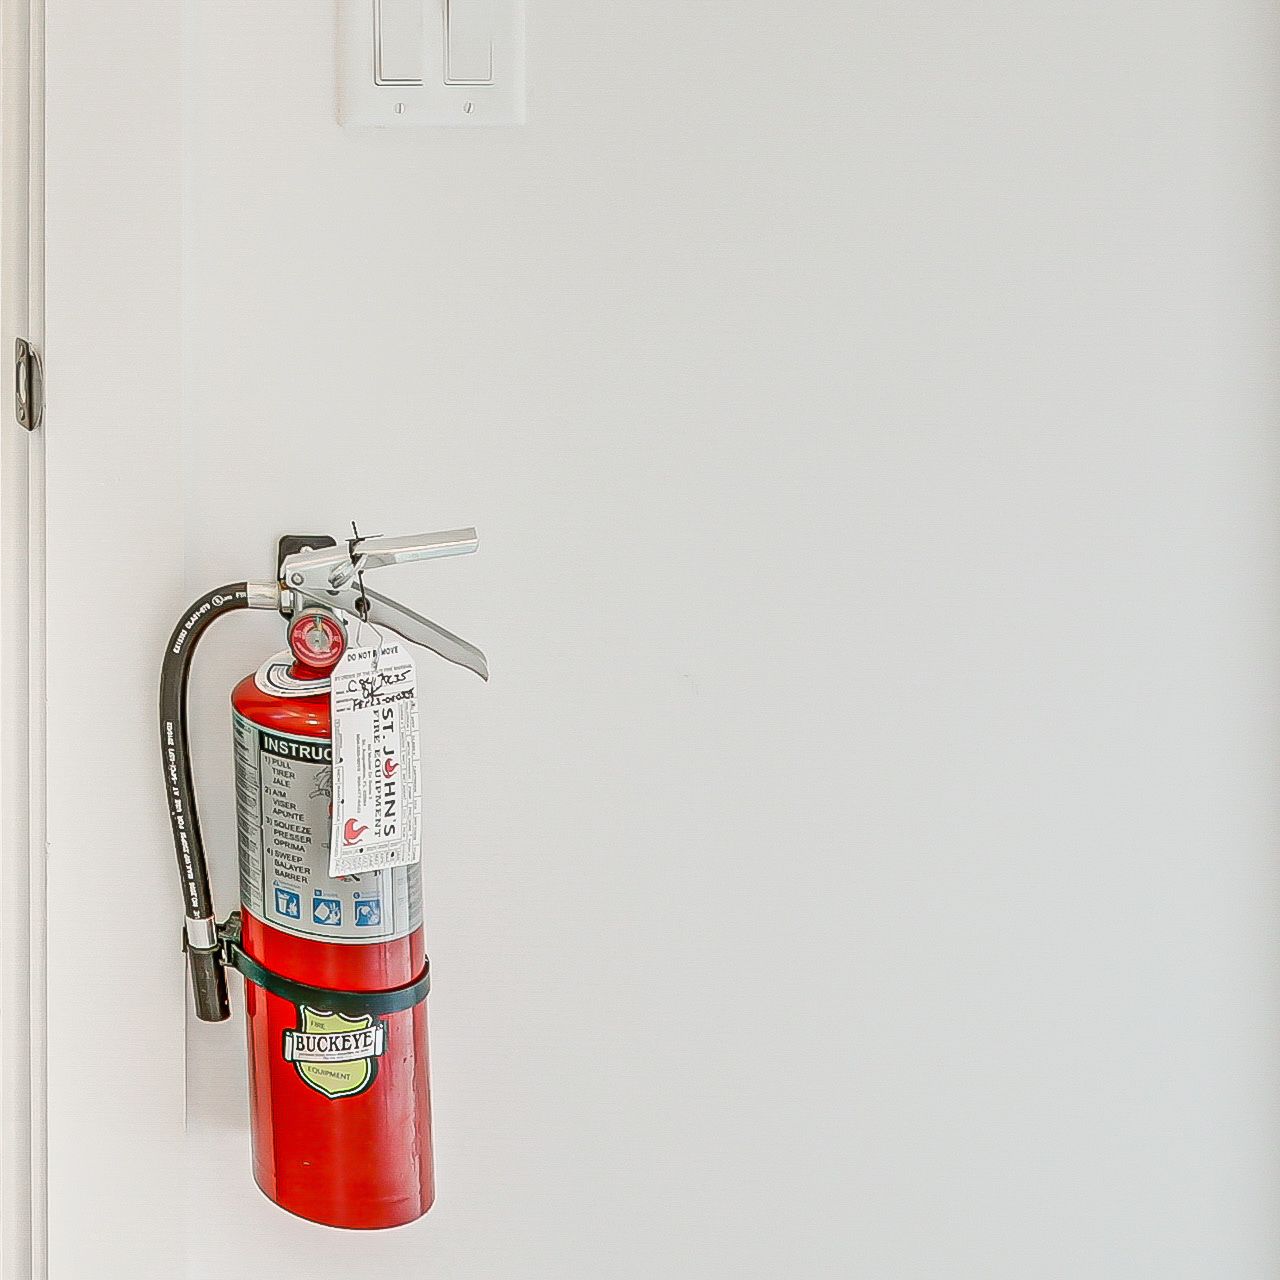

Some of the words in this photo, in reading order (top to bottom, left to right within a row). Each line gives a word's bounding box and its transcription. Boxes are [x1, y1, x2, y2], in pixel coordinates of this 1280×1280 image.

[347, 653, 356, 662] DO
[359, 651, 371, 659] NOT
[373, 710, 381, 744] FIRE
[382, 707, 394, 740] ST.
[272, 757, 291, 769] PULL
[272, 767, 295, 779] TIRER
[373, 749, 382, 838] EQUIPMENT
[273, 808, 304, 821] APUNTE
[274, 820, 312, 835] SQUEEZE
[274, 829, 312, 844] PRESSER
[274, 838, 305, 852] OPRIMA
[275, 850, 302, 862] SWEEP
[275, 869, 308, 884] BARRER
[310, 1020, 326, 1031] FIRE
[295, 1030, 374, 1053] BUCKEYE
[307, 1066, 351, 1080] EQUIPMENT
